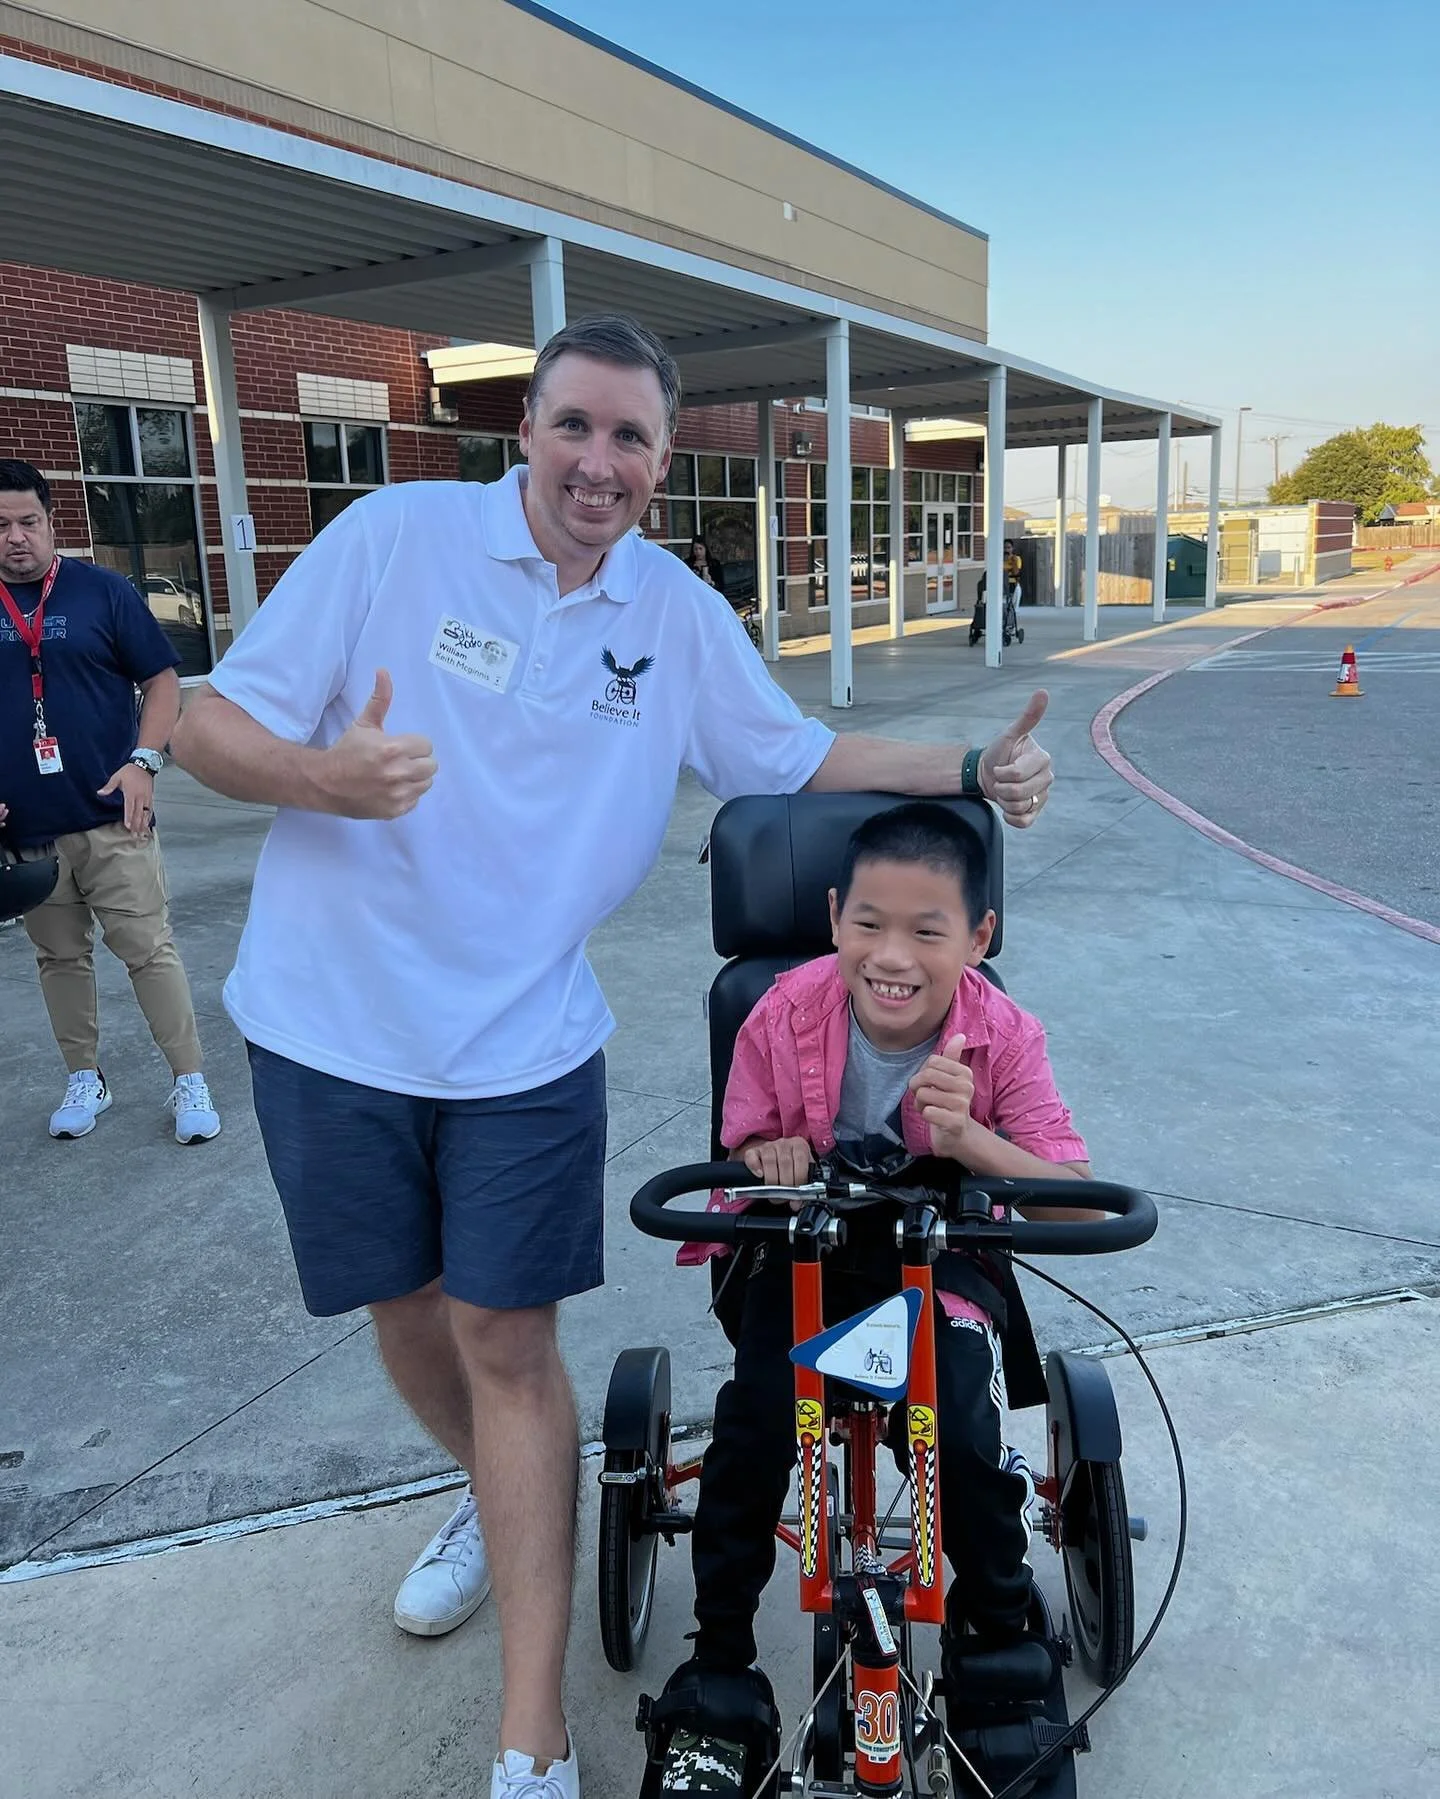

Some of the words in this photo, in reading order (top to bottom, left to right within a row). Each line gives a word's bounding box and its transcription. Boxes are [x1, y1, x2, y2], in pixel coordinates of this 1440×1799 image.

[237, 519, 252, 550] 1
[439, 642, 467, 661] William
[435, 651, 455, 665] Keith
[456, 661, 490, 681] Mcginnis
[590, 712, 640, 728] FOUNDATION
[592, 700, 629, 719] Believe
[632, 708, 641, 721] It
[950, 1319, 983, 1334] adidas
[858, 1691, 897, 1744] 30
